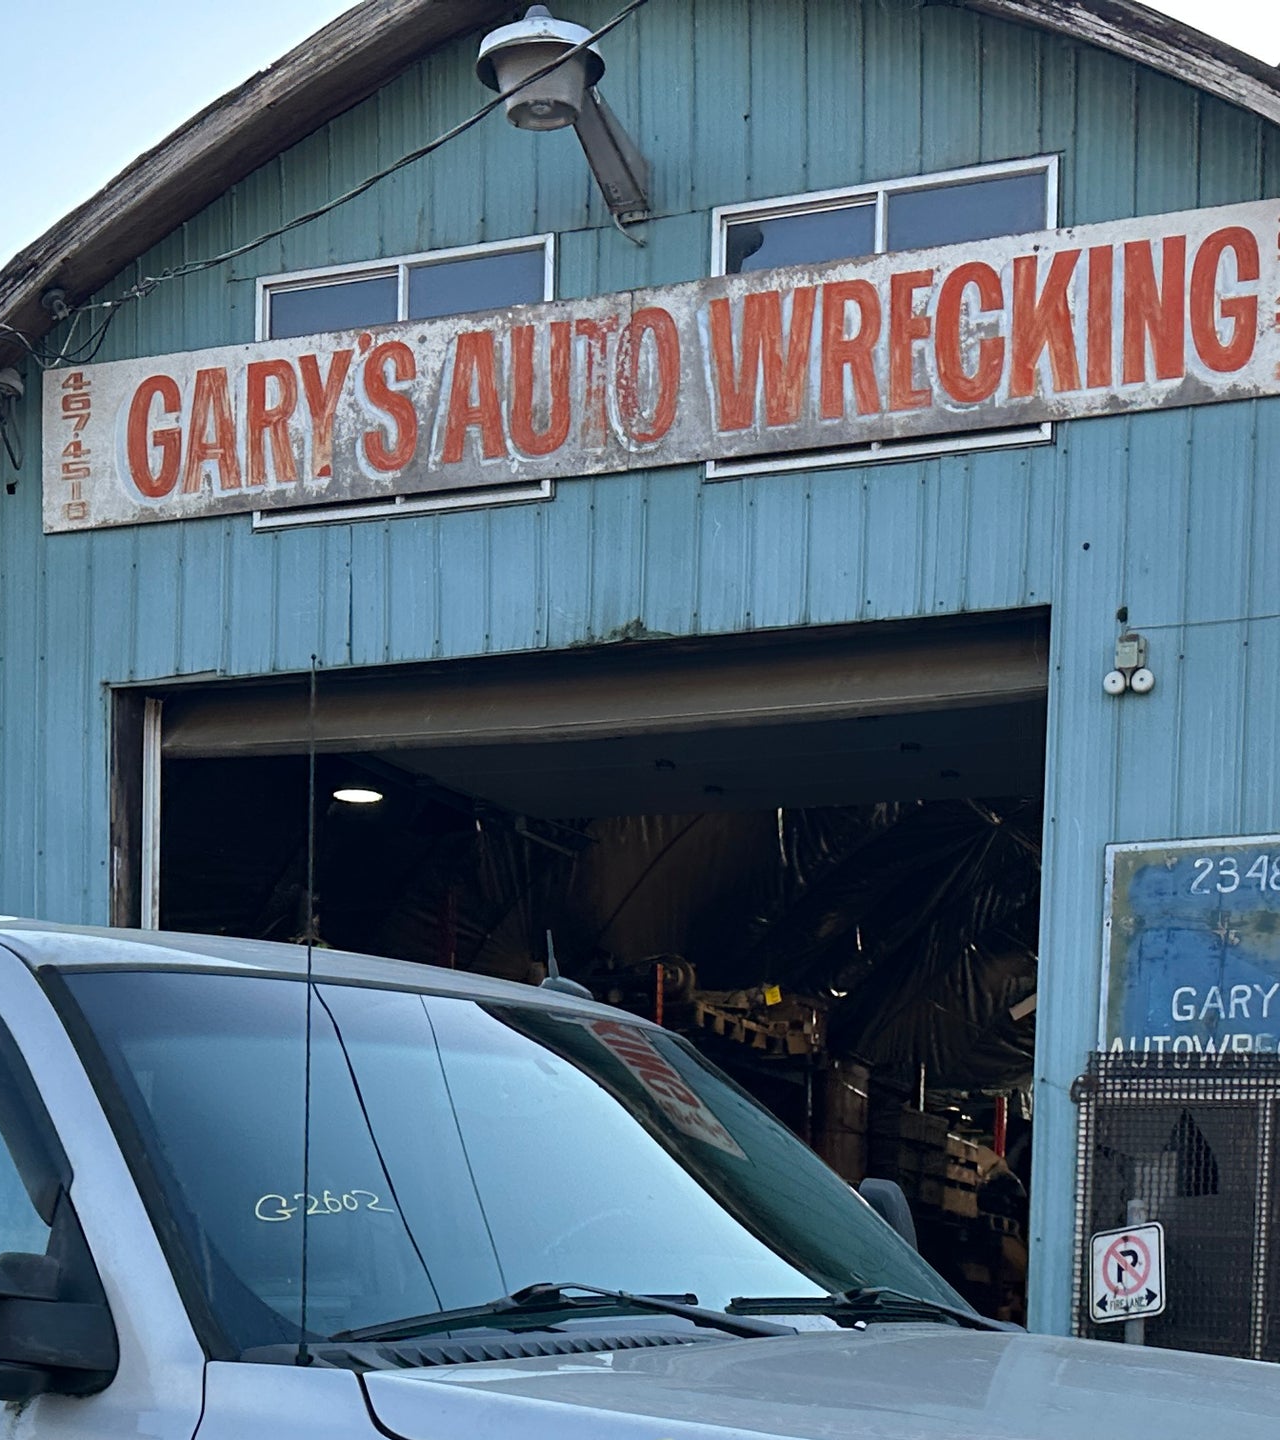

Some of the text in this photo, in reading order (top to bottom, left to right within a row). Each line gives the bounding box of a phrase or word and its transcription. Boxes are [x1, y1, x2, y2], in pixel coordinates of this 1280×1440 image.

[126, 226, 1261, 499] GARY'S AUTO WRECKING
[255, 1189, 395, 1221] G2602
